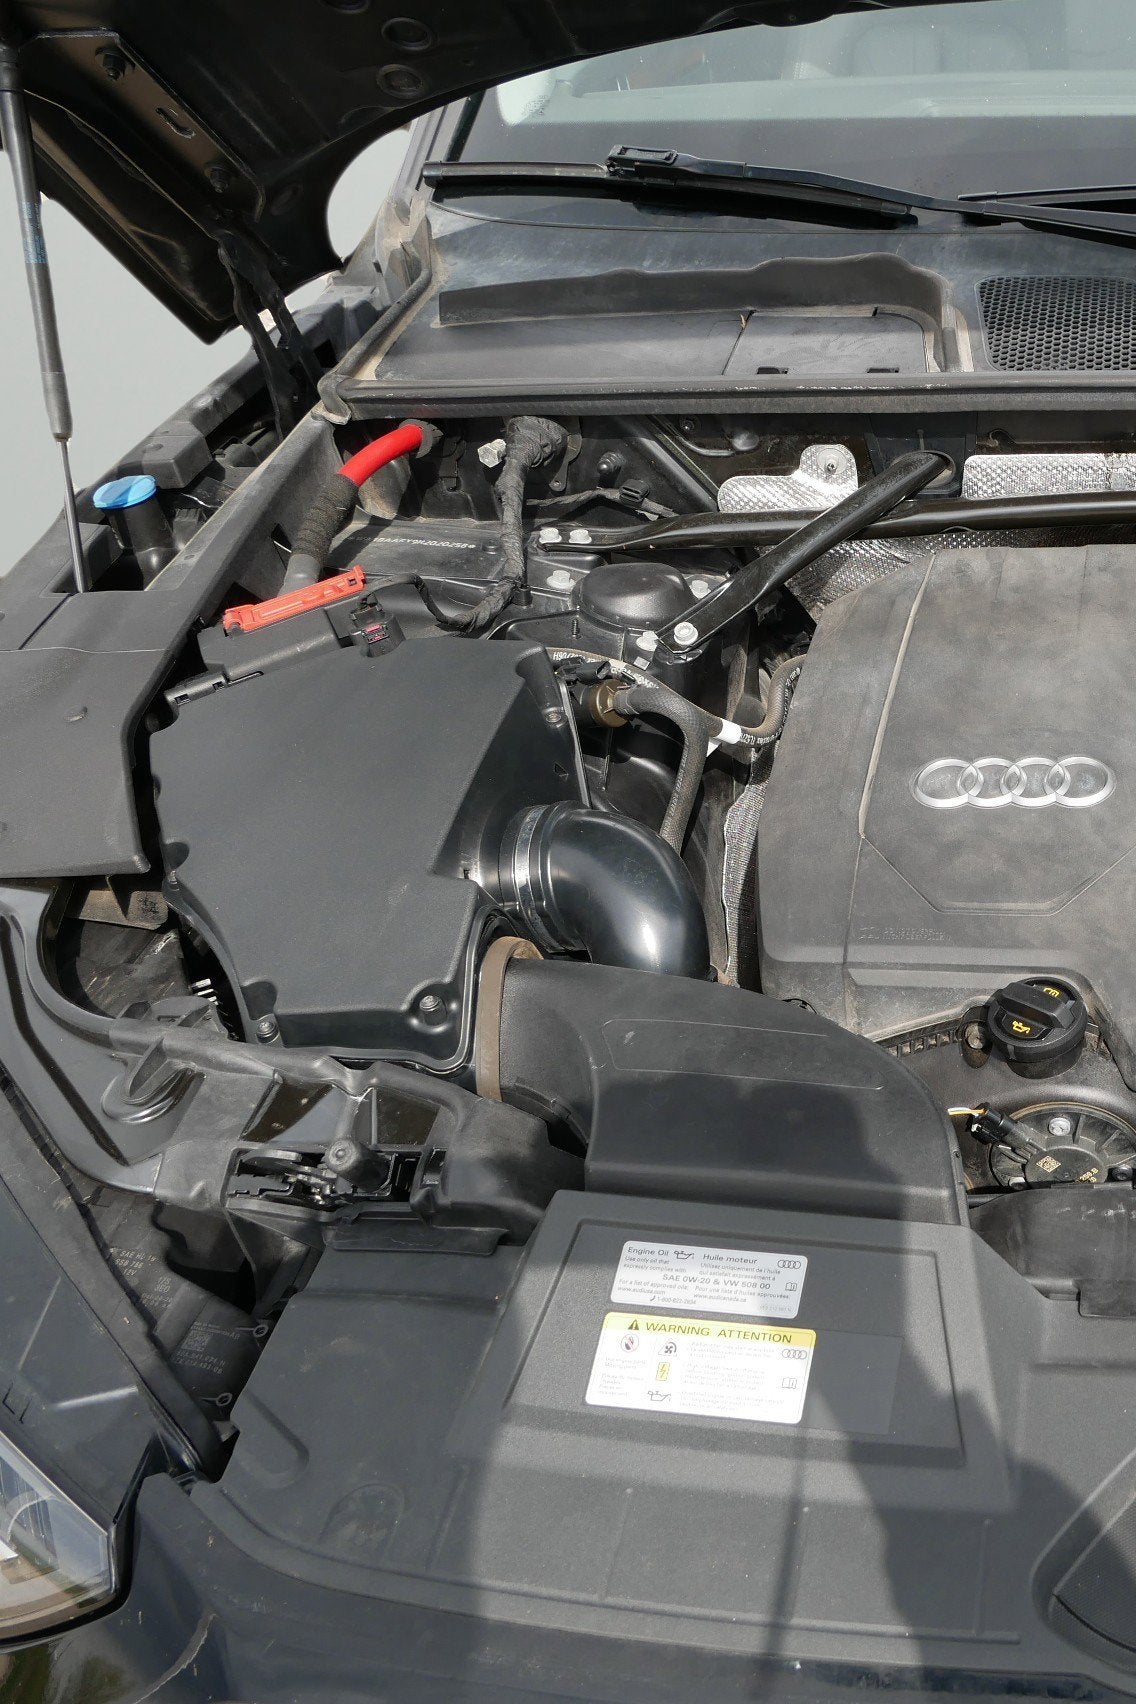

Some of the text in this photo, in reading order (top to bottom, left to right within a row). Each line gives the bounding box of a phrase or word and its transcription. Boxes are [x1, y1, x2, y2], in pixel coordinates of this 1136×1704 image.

[627, 1246, 655, 1256] Engine
[703, 1253, 724, 1261] Huile
[623, 1263, 649, 1271] expressly
[649, 1265, 674, 1273] complies
[650, 1281, 677, 1289] approved
[662, 1274, 680, 1282] SAE
[682, 1275, 711, 1284] 0W-20
[723, 1279, 740, 1287] VW
[741, 1281, 758, 1289] 508
[759, 1282, 771, 1290] 00
[646, 1322, 793, 1344] WARNING ATTENTION
